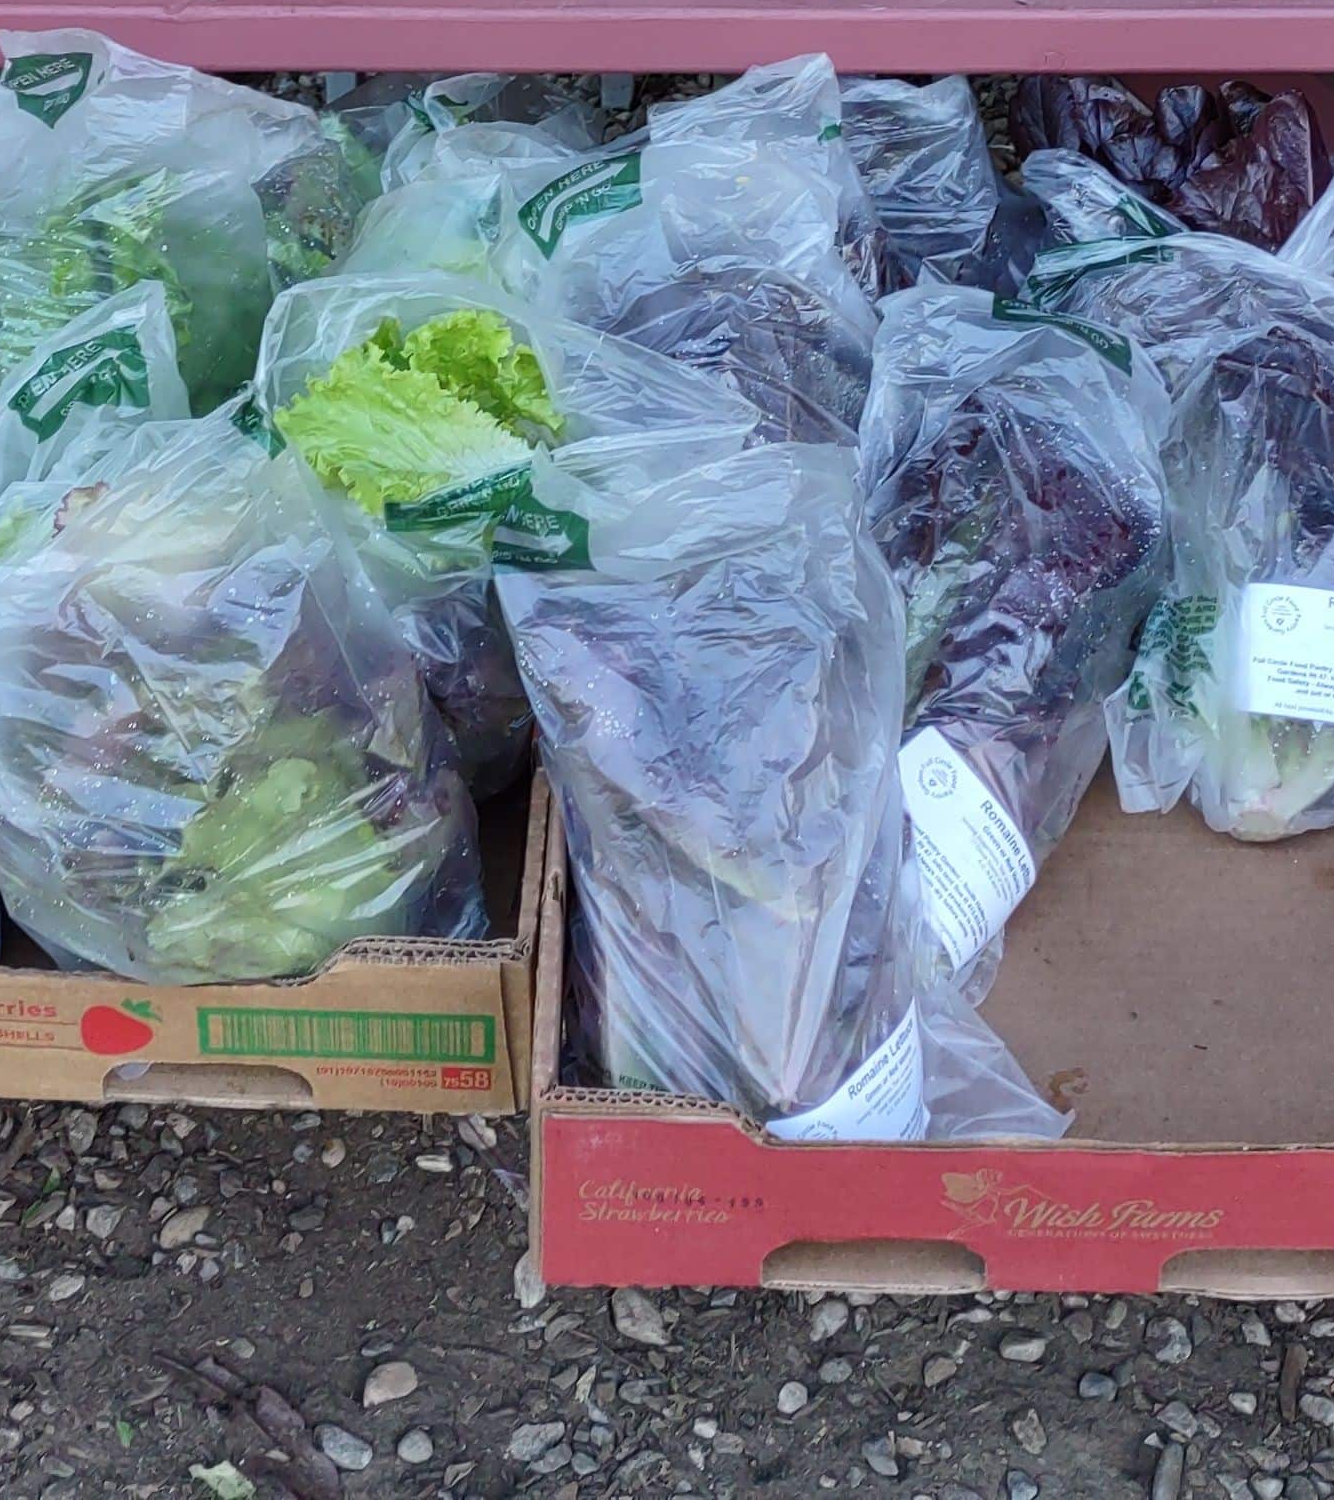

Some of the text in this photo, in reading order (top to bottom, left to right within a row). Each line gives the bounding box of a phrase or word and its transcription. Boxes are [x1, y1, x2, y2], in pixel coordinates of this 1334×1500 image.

[528, 160, 606, 230] OPEN HERE
[979, 799, 1021, 857] Romaine
[847, 1053, 890, 1101] Romaine
[578, 1179, 702, 1206] California
[578, 1200, 729, 1223] Strawberries
[1003, 1198, 1224, 1231] Wish Farms
